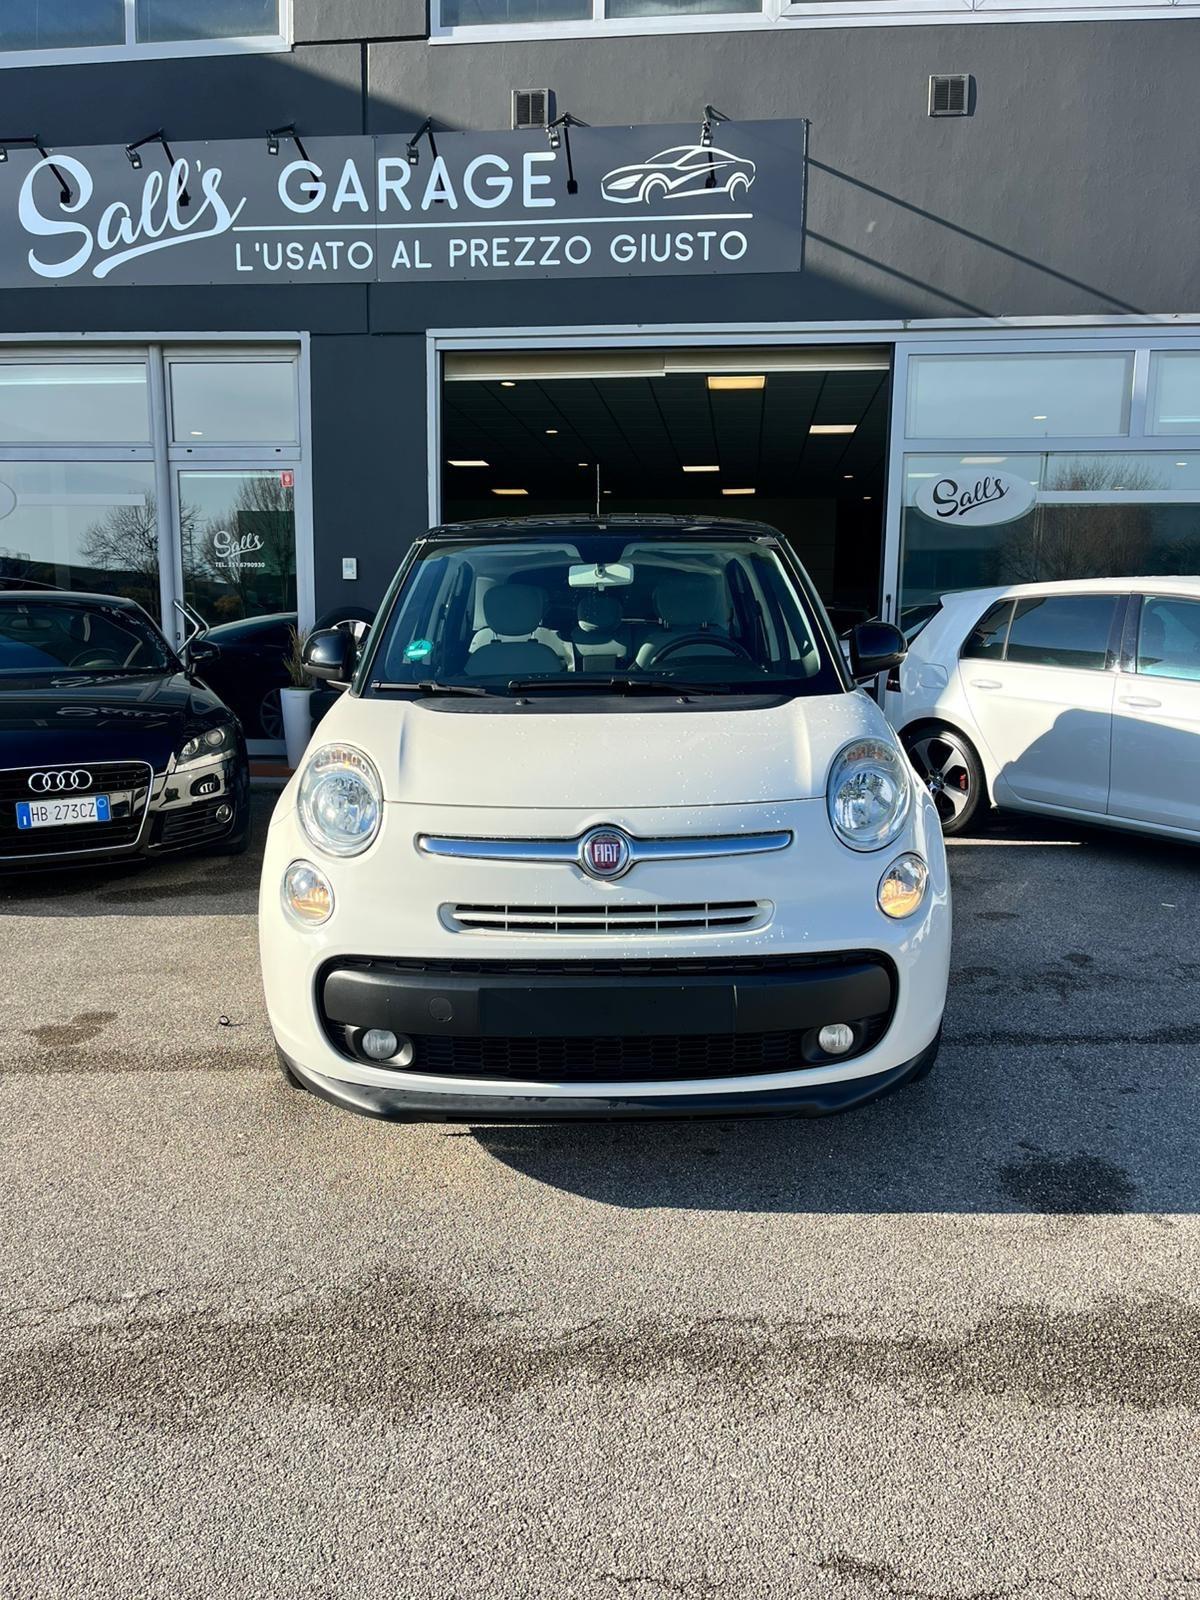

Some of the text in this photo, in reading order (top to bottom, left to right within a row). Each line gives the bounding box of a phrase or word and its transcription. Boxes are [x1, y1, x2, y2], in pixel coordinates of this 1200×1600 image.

[18, 152, 556, 279] Sall's GARAGE
[236, 230, 748, 272] L'USATO AL PREZZO GIUSTO
[932, 476, 1010, 517] Sall's
[213, 530, 265, 558] Sall's
[31, 806, 49, 822] HB
[54, 802, 96, 820] 273CZ
[594, 843, 619, 863] FIAT
